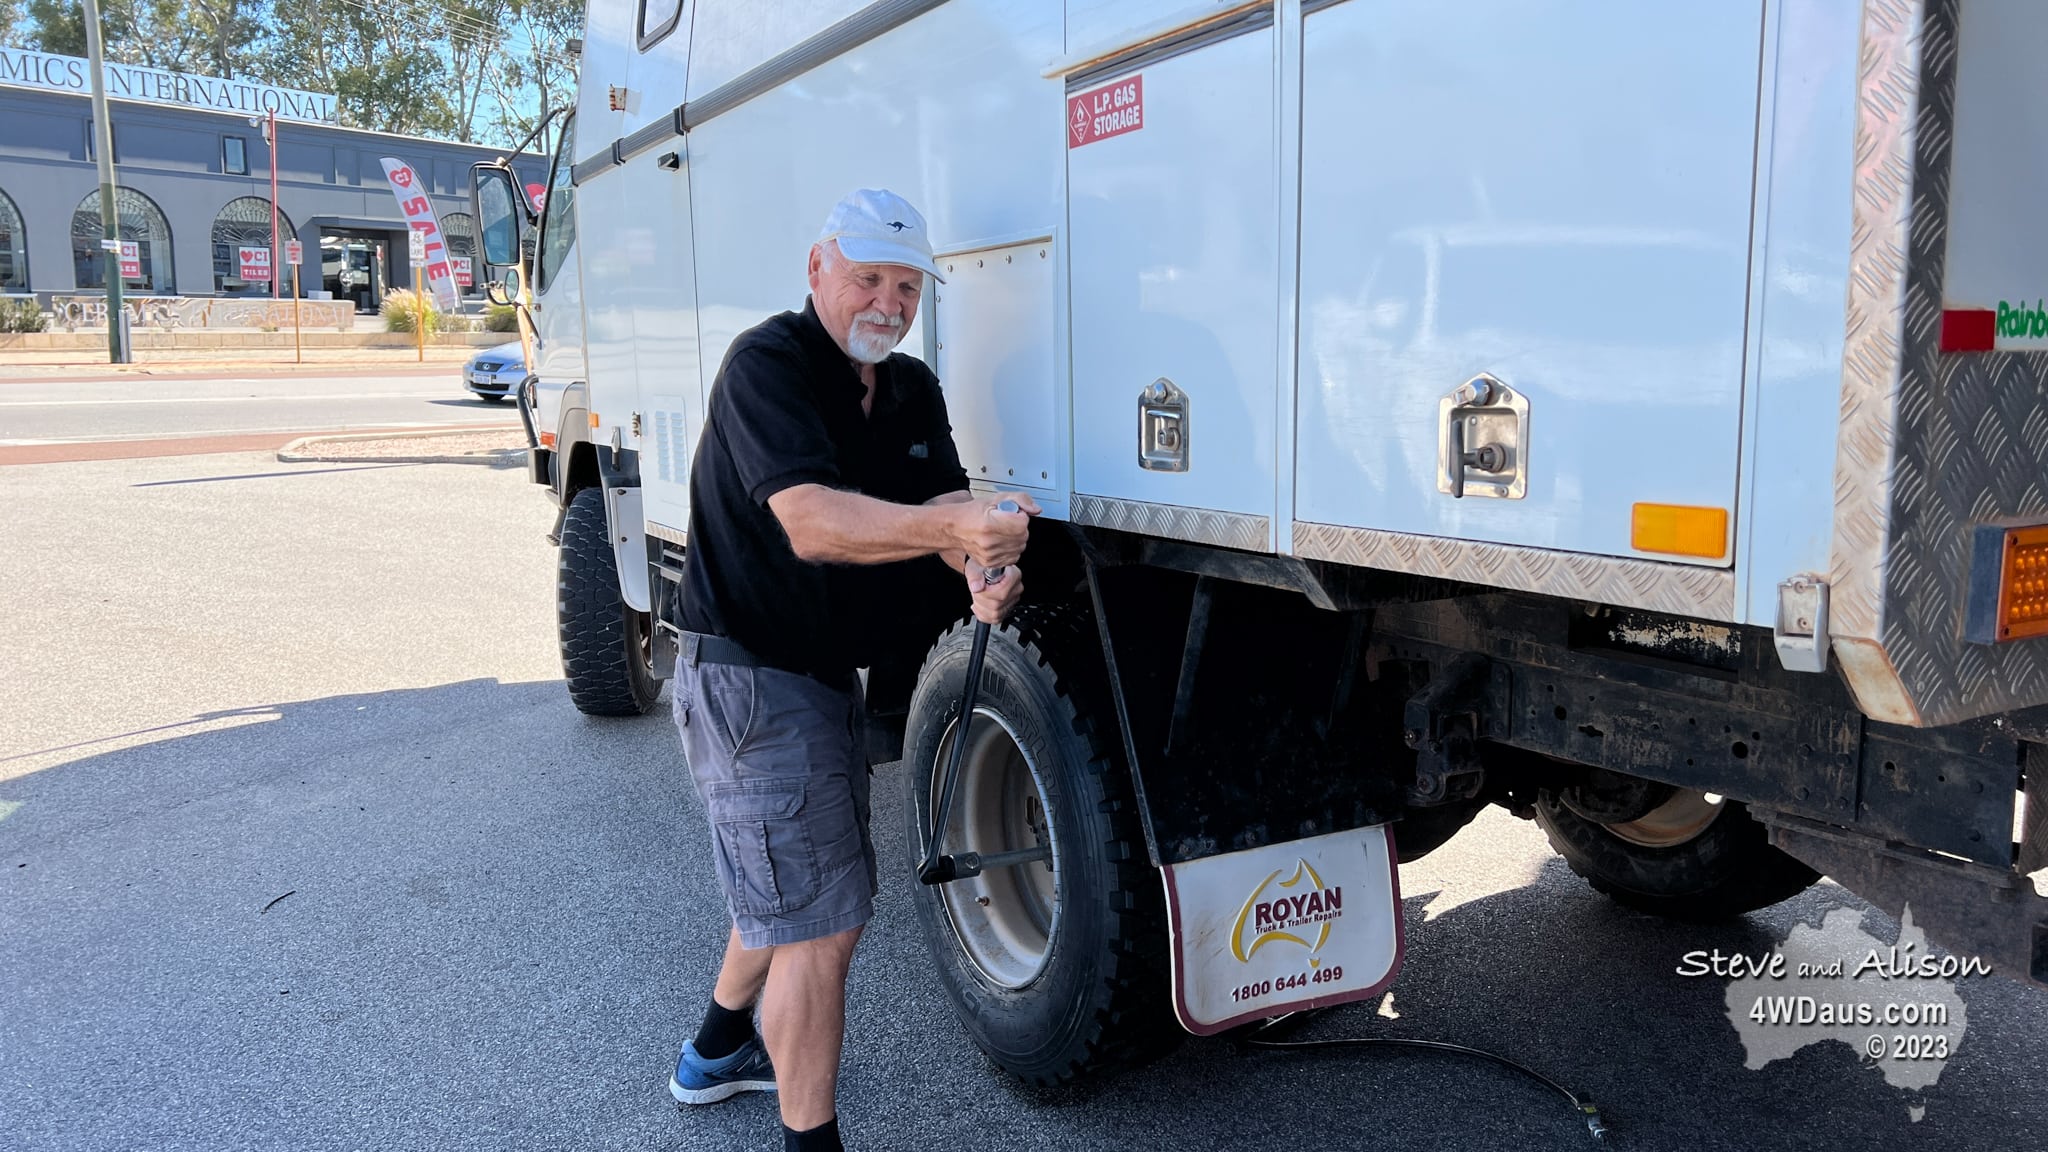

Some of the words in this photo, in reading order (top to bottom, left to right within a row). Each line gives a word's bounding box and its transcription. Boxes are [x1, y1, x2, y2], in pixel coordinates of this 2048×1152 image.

[104, 65, 336, 122] NTERNATIONAL
[1094, 92, 1112, 114] L.P.
[1114, 83, 1136, 108] GAS
[1094, 105, 1140, 136] STORAGE
[254, 251, 269, 262] CI
[1996, 298, 2048, 339] Rainb
[1255, 886, 1342, 926] ROYAN
[1255, 923, 1277, 935] Truck
[1279, 921, 1285, 930] &
[1287, 916, 1312, 928] Trailer
[1314, 909, 1342, 923] Repairs
[1231, 980, 1270, 1002] 1800
[1275, 972, 1307, 990] 644
[1311, 966, 1343, 984] 499
